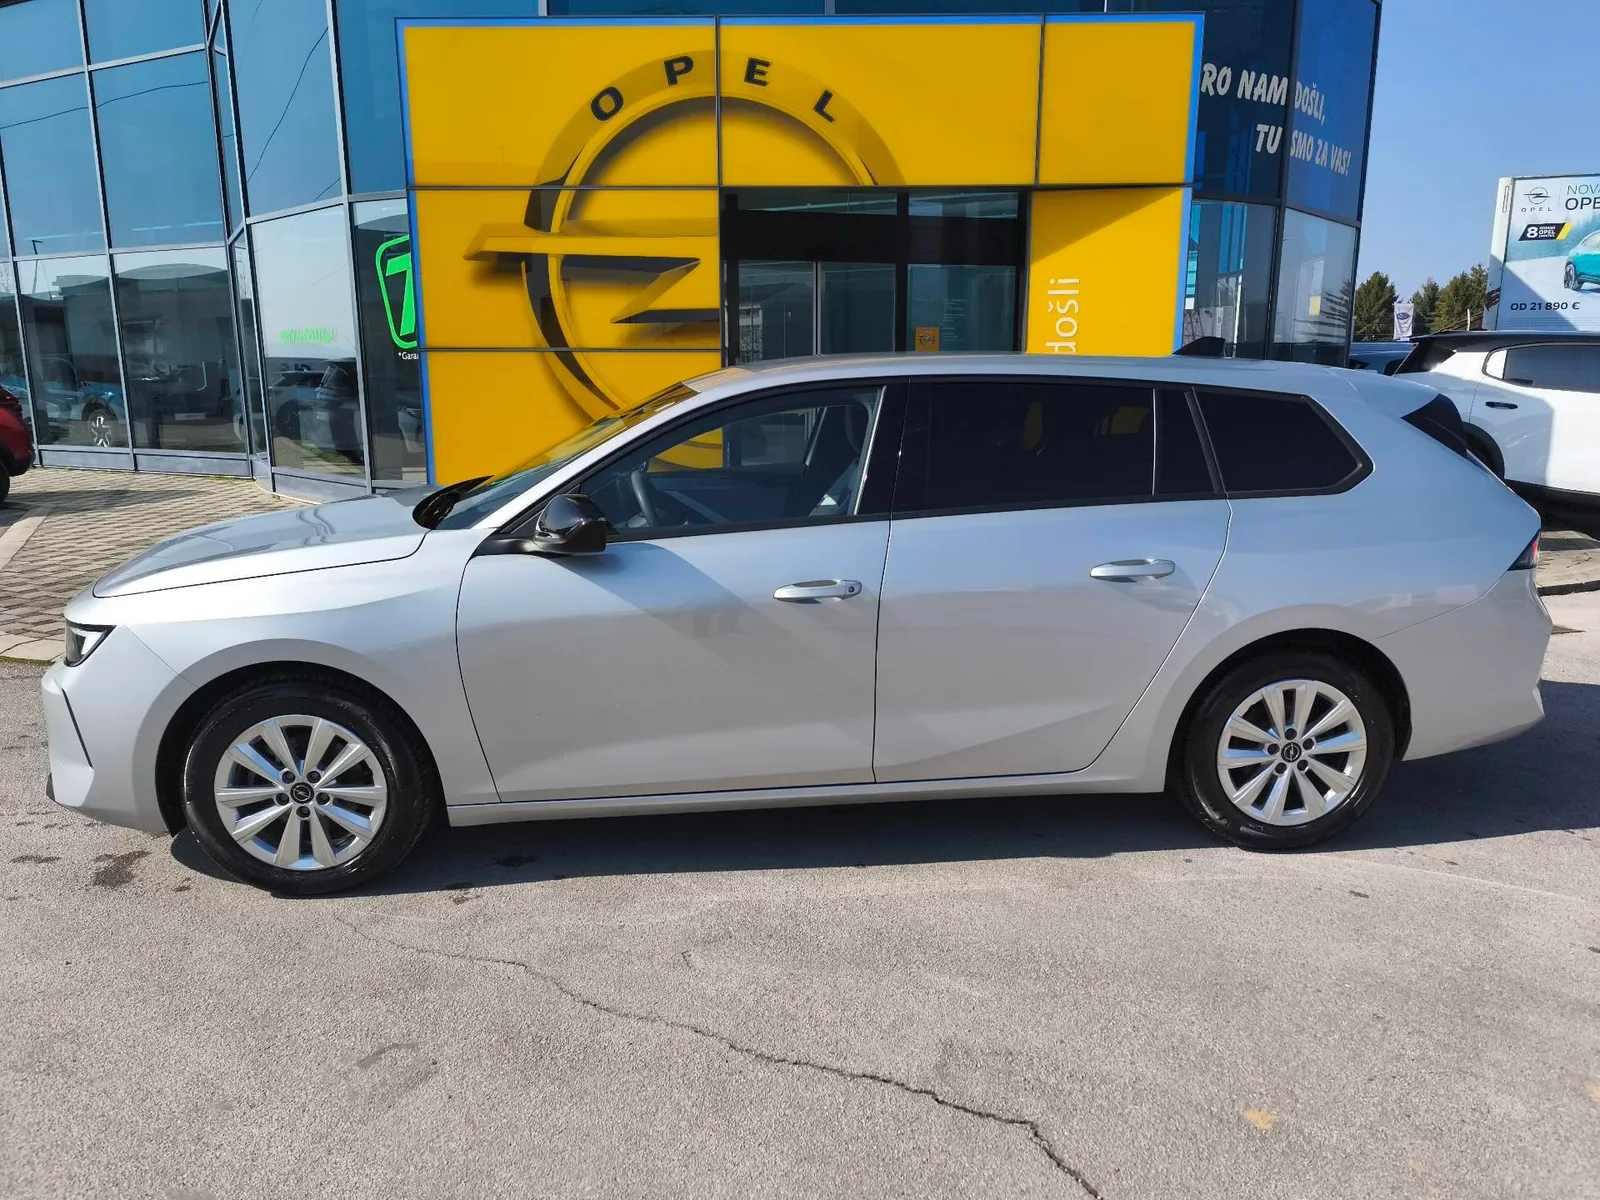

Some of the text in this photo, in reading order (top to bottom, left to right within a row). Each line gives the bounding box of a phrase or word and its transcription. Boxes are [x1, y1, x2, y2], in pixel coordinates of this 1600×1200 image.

[590, 56, 836, 123] OPEL
[1237, 69, 1289, 106] NAM
[1294, 81, 1326, 126] DOŠLI,
[1255, 123, 1352, 176] TU SMO ZA VAS!
[1526, 226, 1539, 239] 8
[1510, 301, 1581, 311] OD 21 890 €
